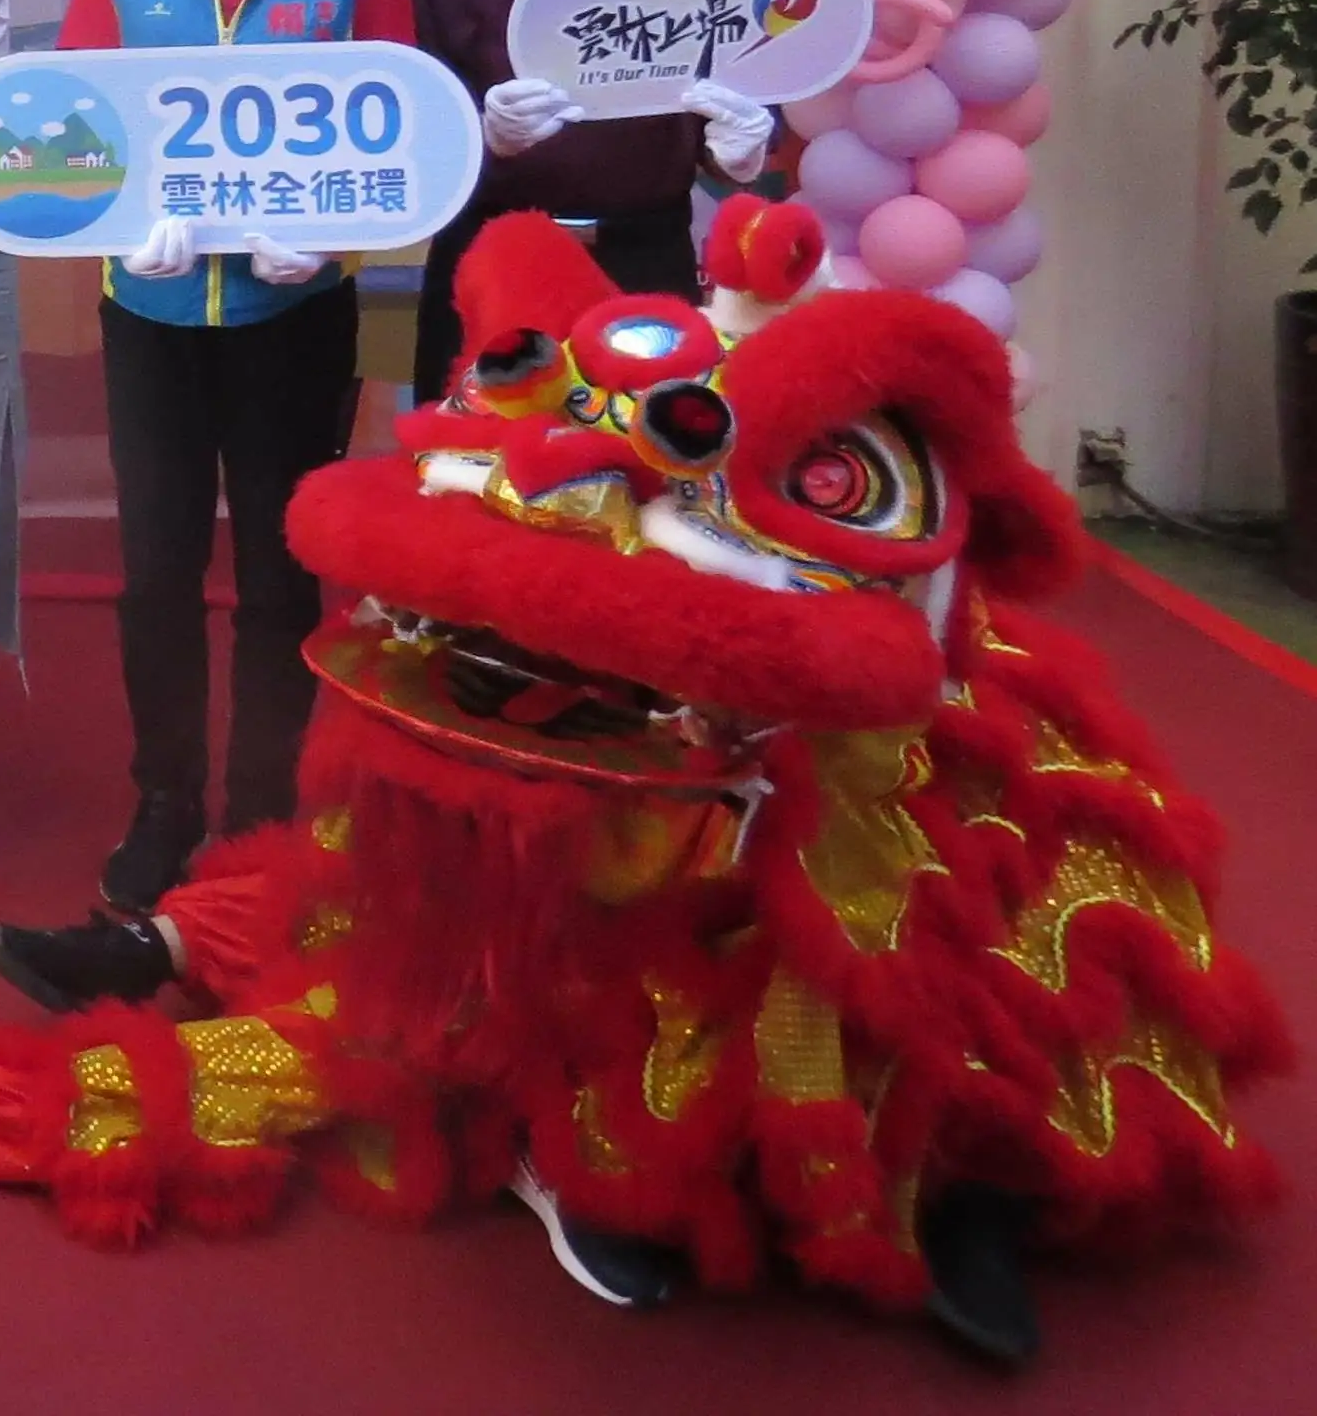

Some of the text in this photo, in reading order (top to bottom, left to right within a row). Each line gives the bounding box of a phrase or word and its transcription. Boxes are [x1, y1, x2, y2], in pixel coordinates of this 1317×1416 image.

[578, 63, 690, 86] It's Our Time
[158, 81, 402, 159] 2030
[160, 168, 408, 217] 雲林全循環
